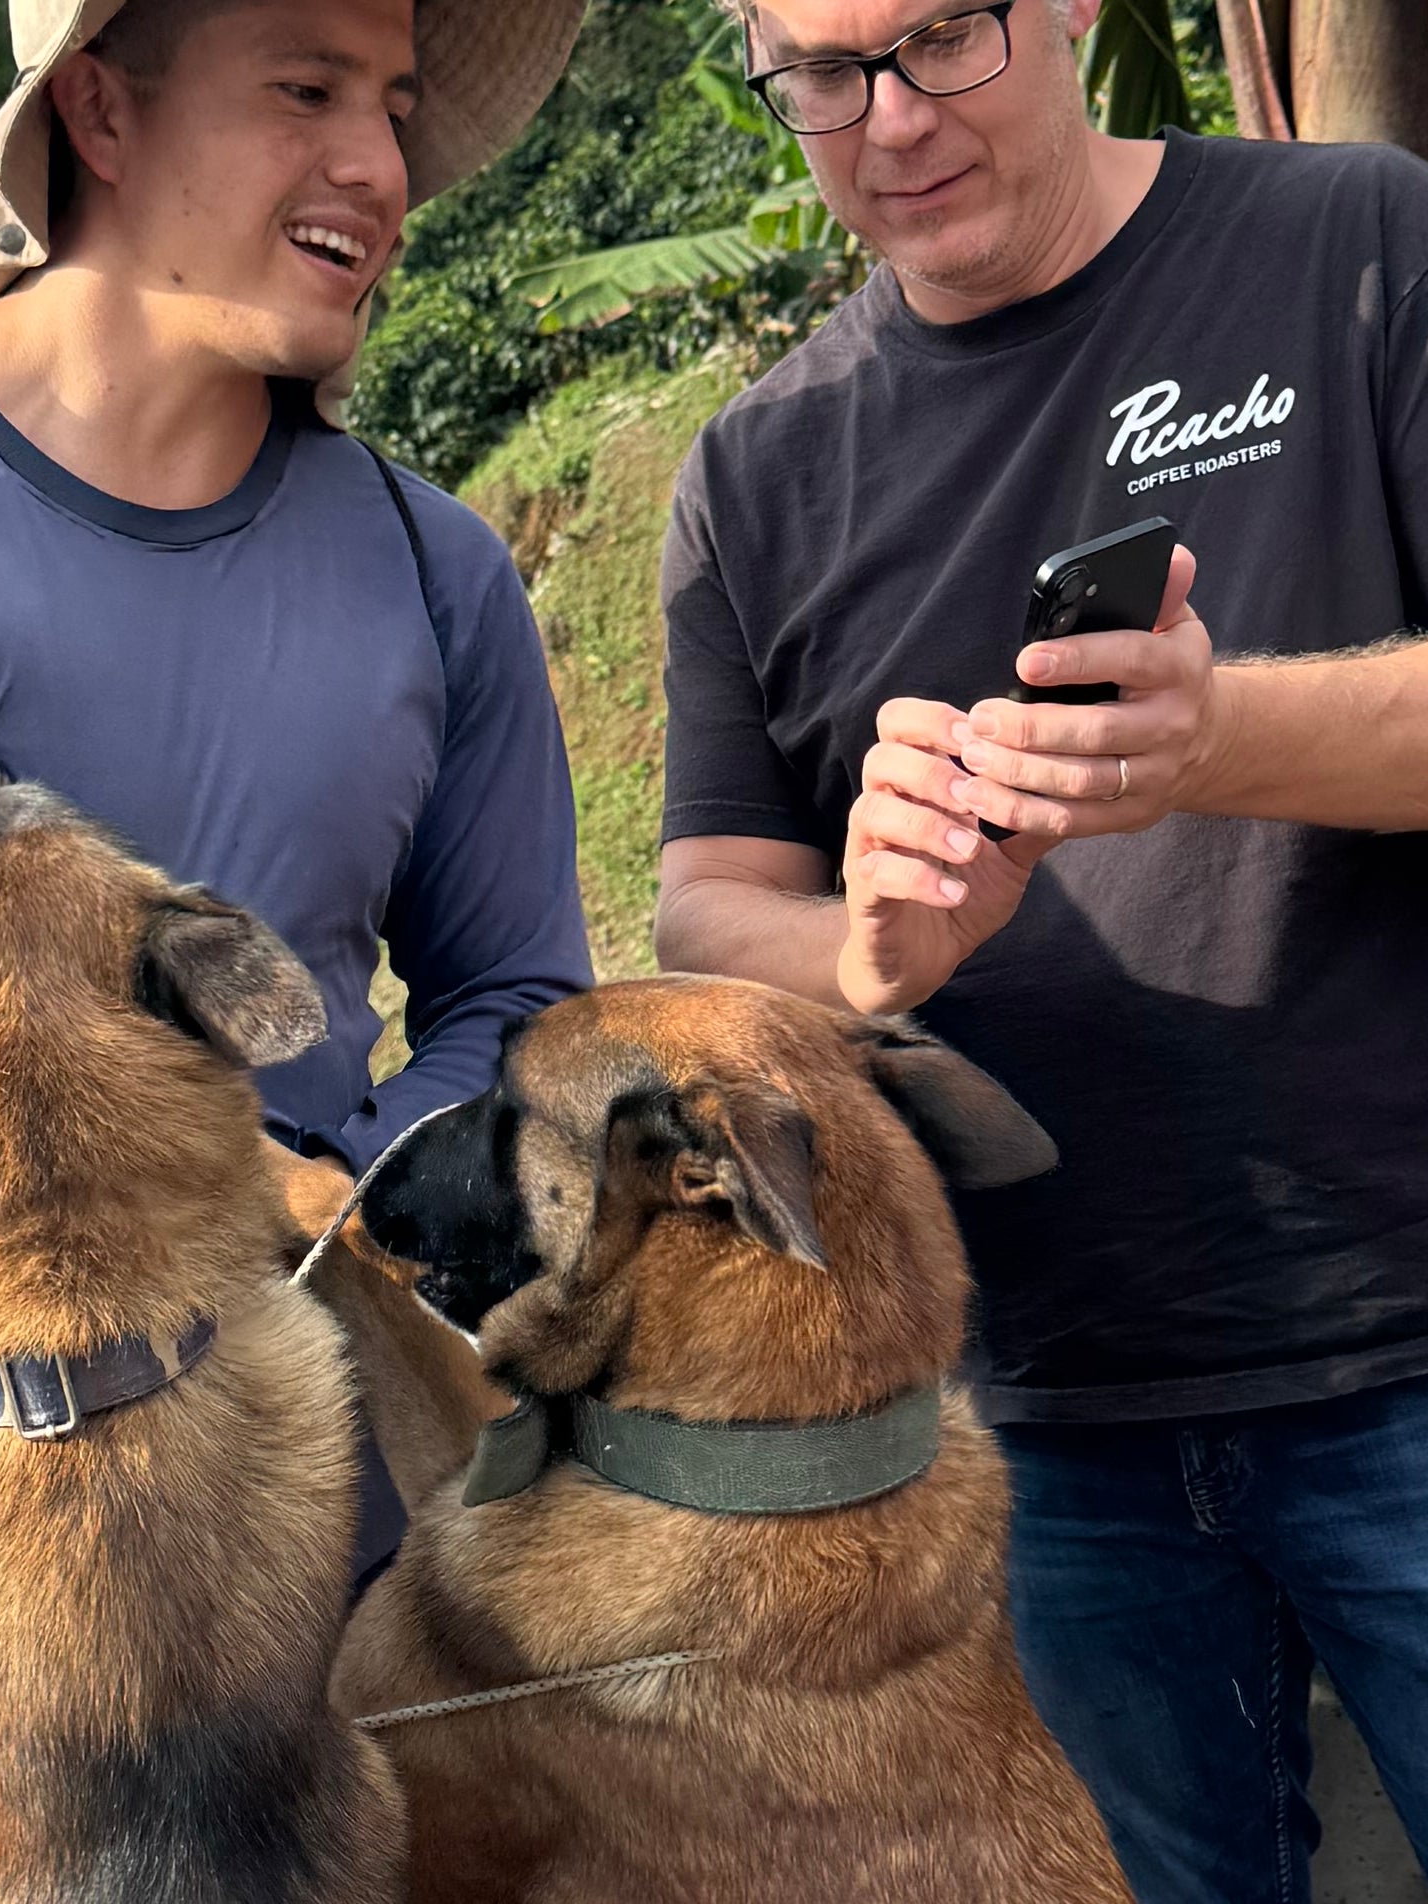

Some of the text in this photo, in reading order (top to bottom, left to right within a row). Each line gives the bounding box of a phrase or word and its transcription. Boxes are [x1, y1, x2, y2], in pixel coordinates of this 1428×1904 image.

[1104, 373, 1296, 467] Picacho
[1126, 439, 1282, 495] COFFEE ROASTERS
